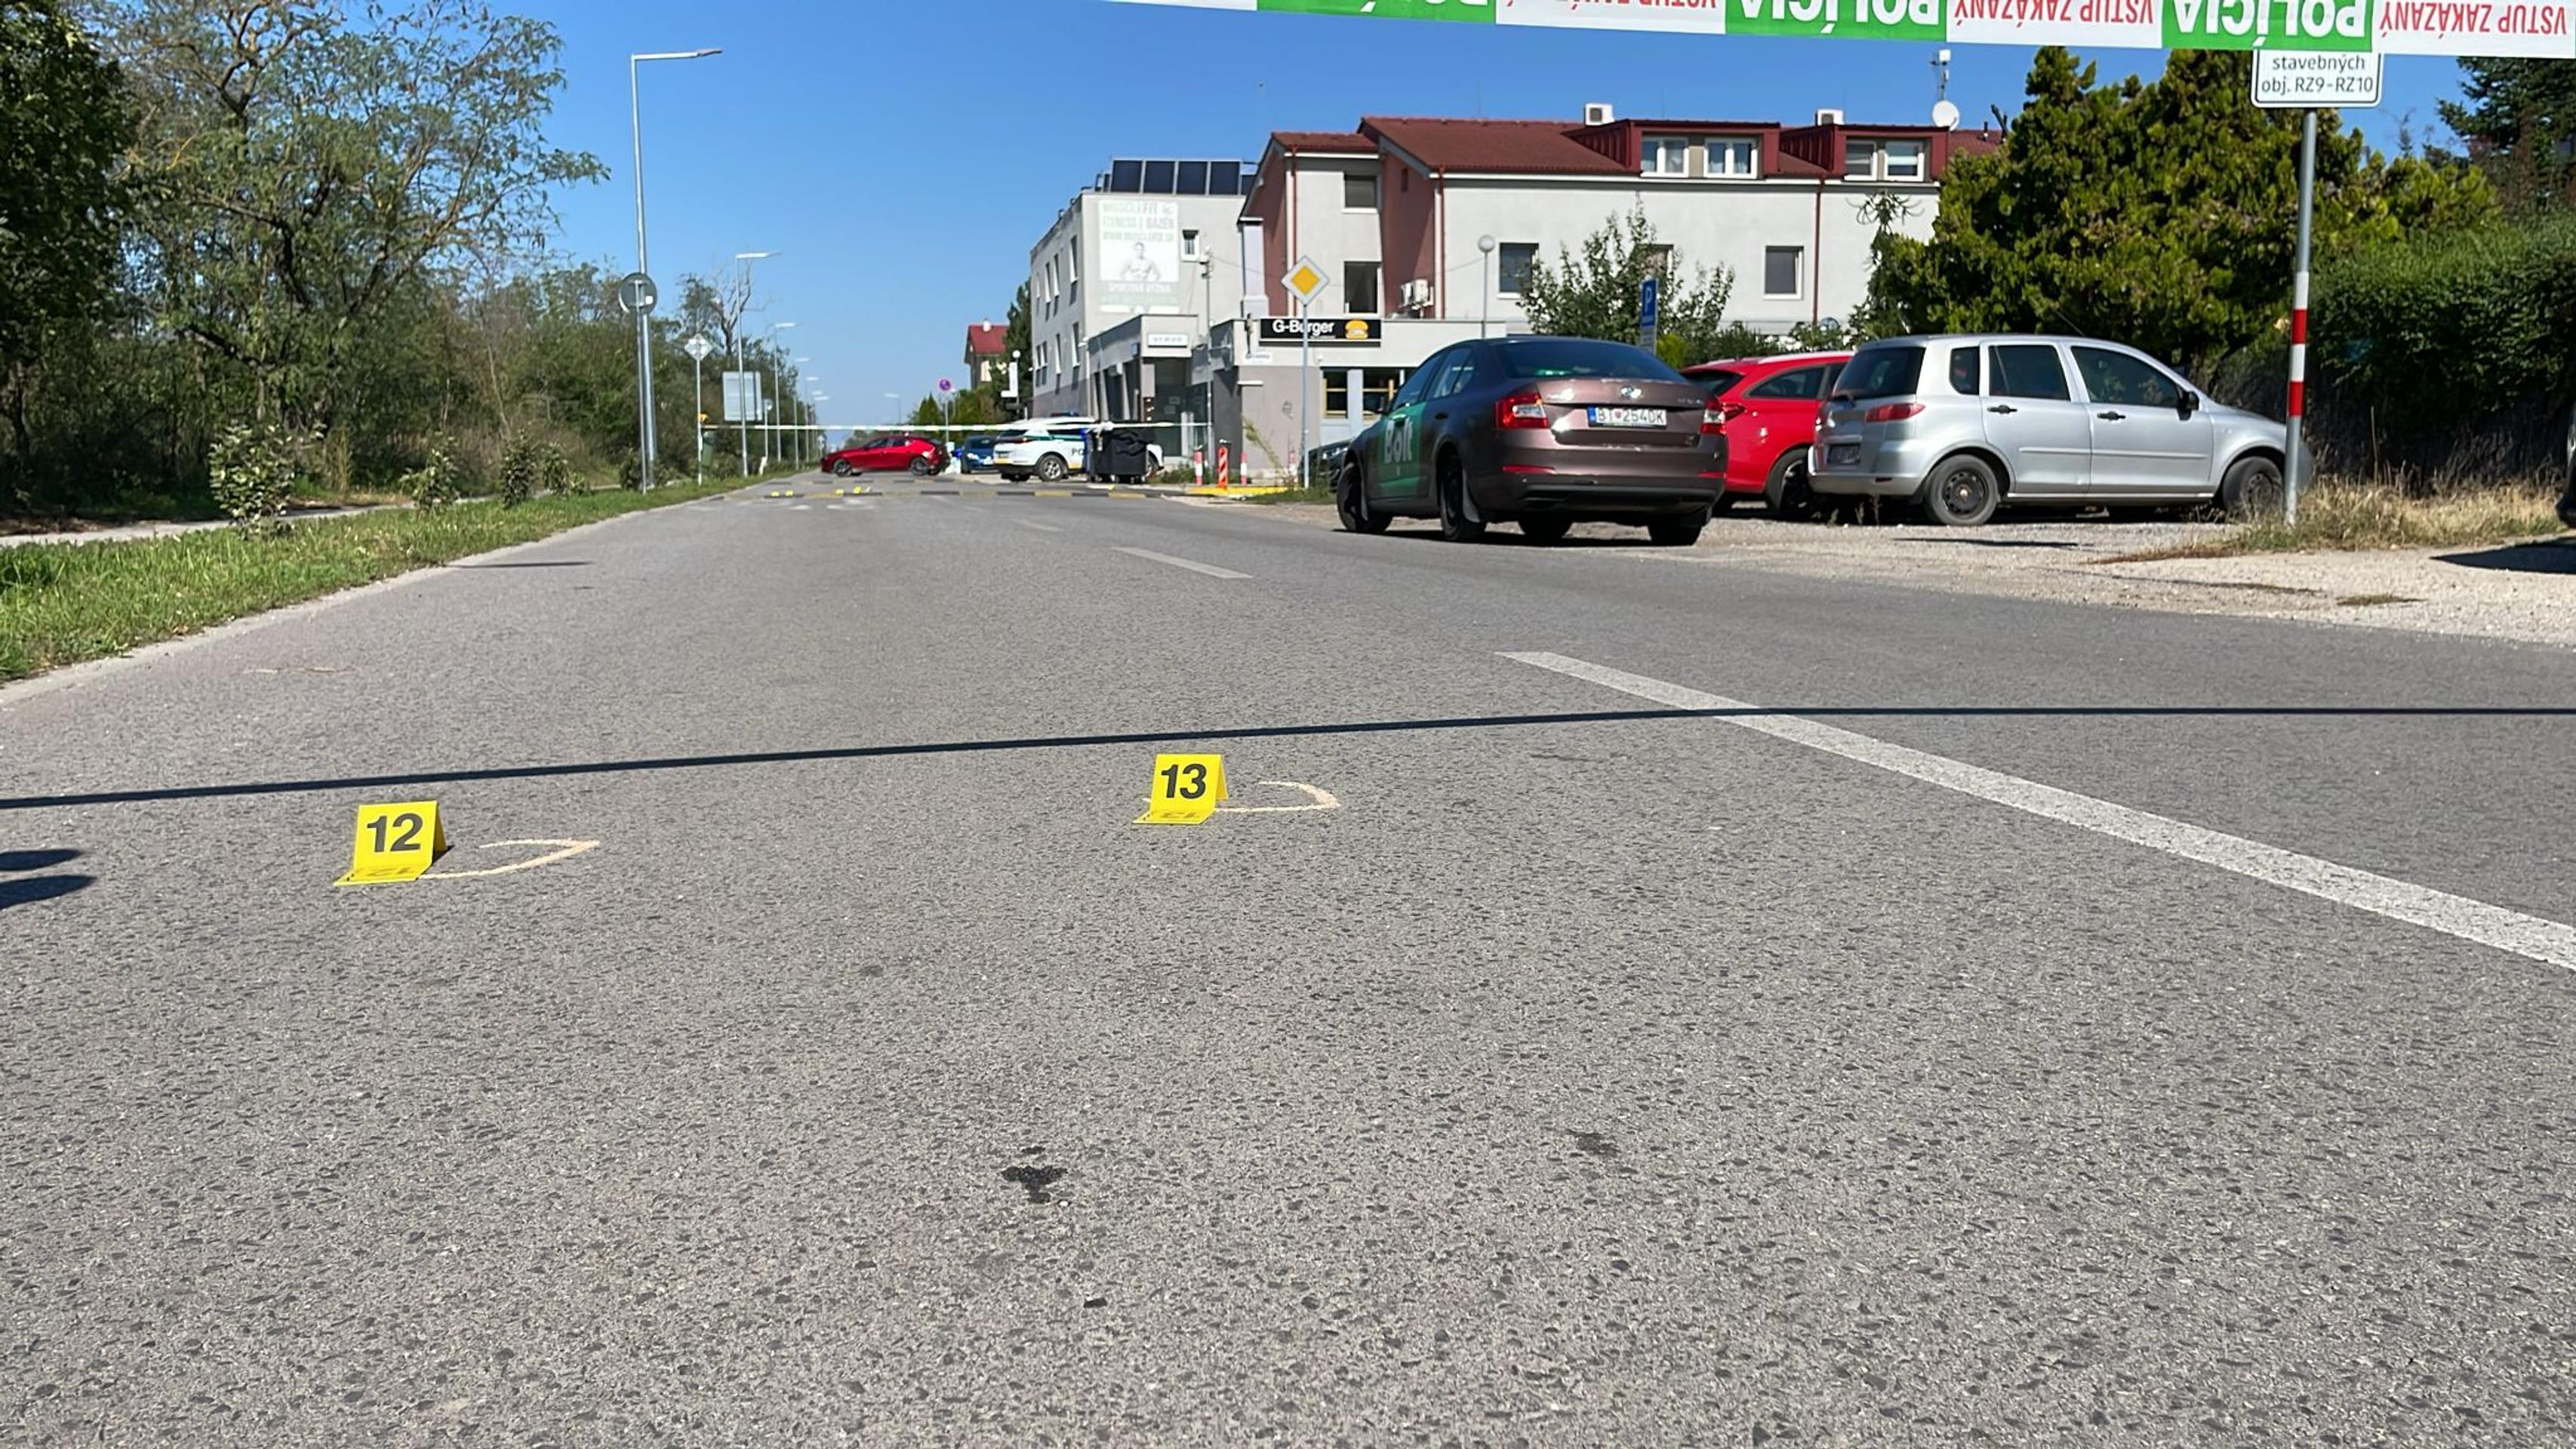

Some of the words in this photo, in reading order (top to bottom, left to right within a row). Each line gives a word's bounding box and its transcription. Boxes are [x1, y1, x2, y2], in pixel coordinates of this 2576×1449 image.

[1954, 0, 2071, 28] ZAKÁZANÝ
[2080, 0, 2153, 23] VSTUP
[2174, 0, 2365, 47] POLÍCIA
[2380, 1, 2492, 39] ZAKÁZANÝ
[2498, 5, 2566, 35] VSTUP
[2273, 54, 2365, 73] stavebných
[2262, 78, 2290, 95] obj.
[1645, 286, 1653, 312] P
[1384, 417, 1414, 464] Bolt
[1161, 764, 1207, 799] 13
[367, 813, 423, 853] 12
